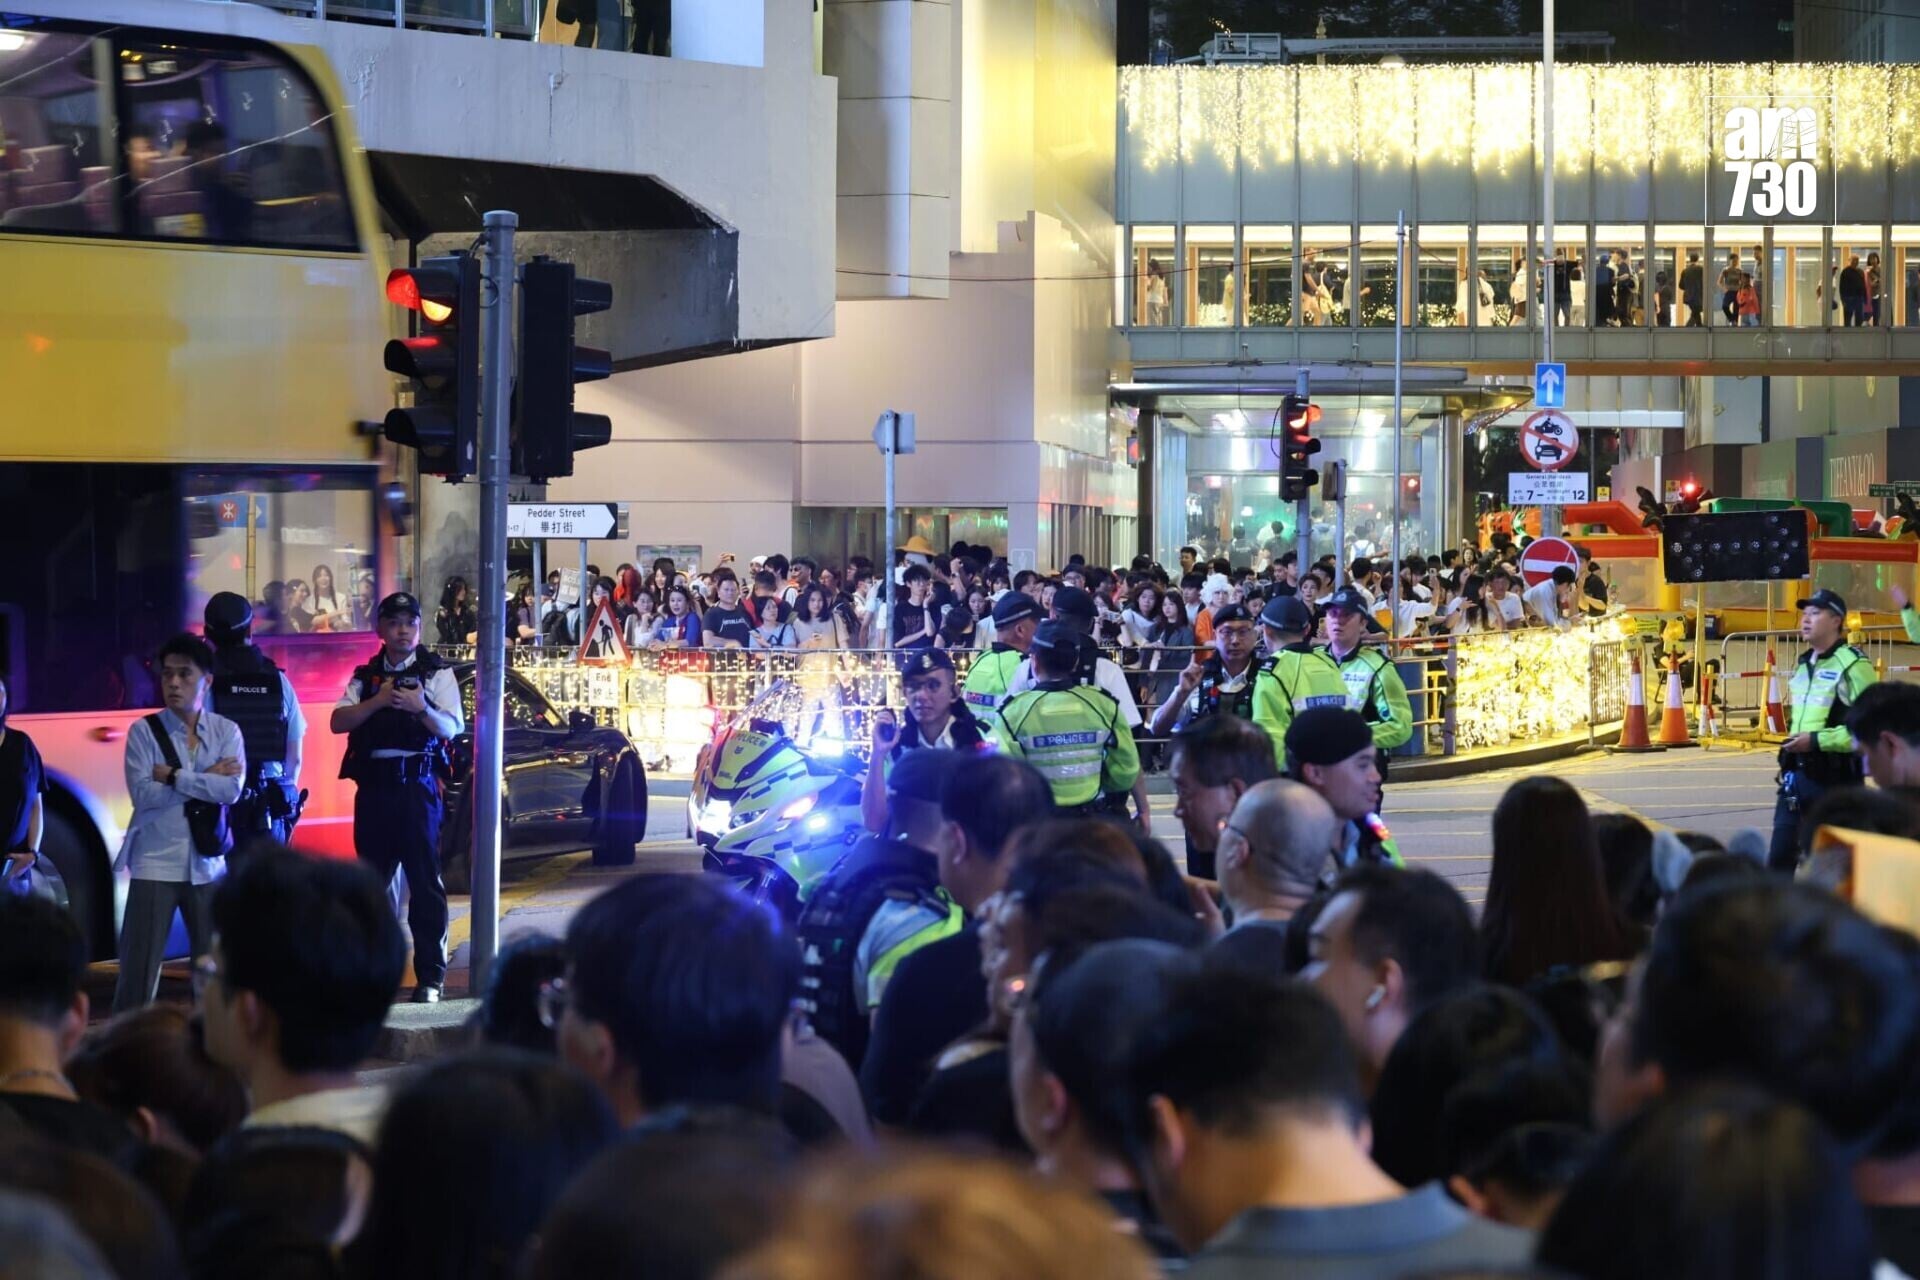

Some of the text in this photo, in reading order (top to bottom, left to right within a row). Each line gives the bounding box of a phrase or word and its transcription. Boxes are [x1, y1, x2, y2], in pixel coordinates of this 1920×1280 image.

[1526, 490, 1534, 500] 7
[1572, 490, 1585, 500] 12
[527, 508, 585, 517] Pedder Street
[596, 672, 611, 682] End
[1047, 732, 1086, 746] POLICE
